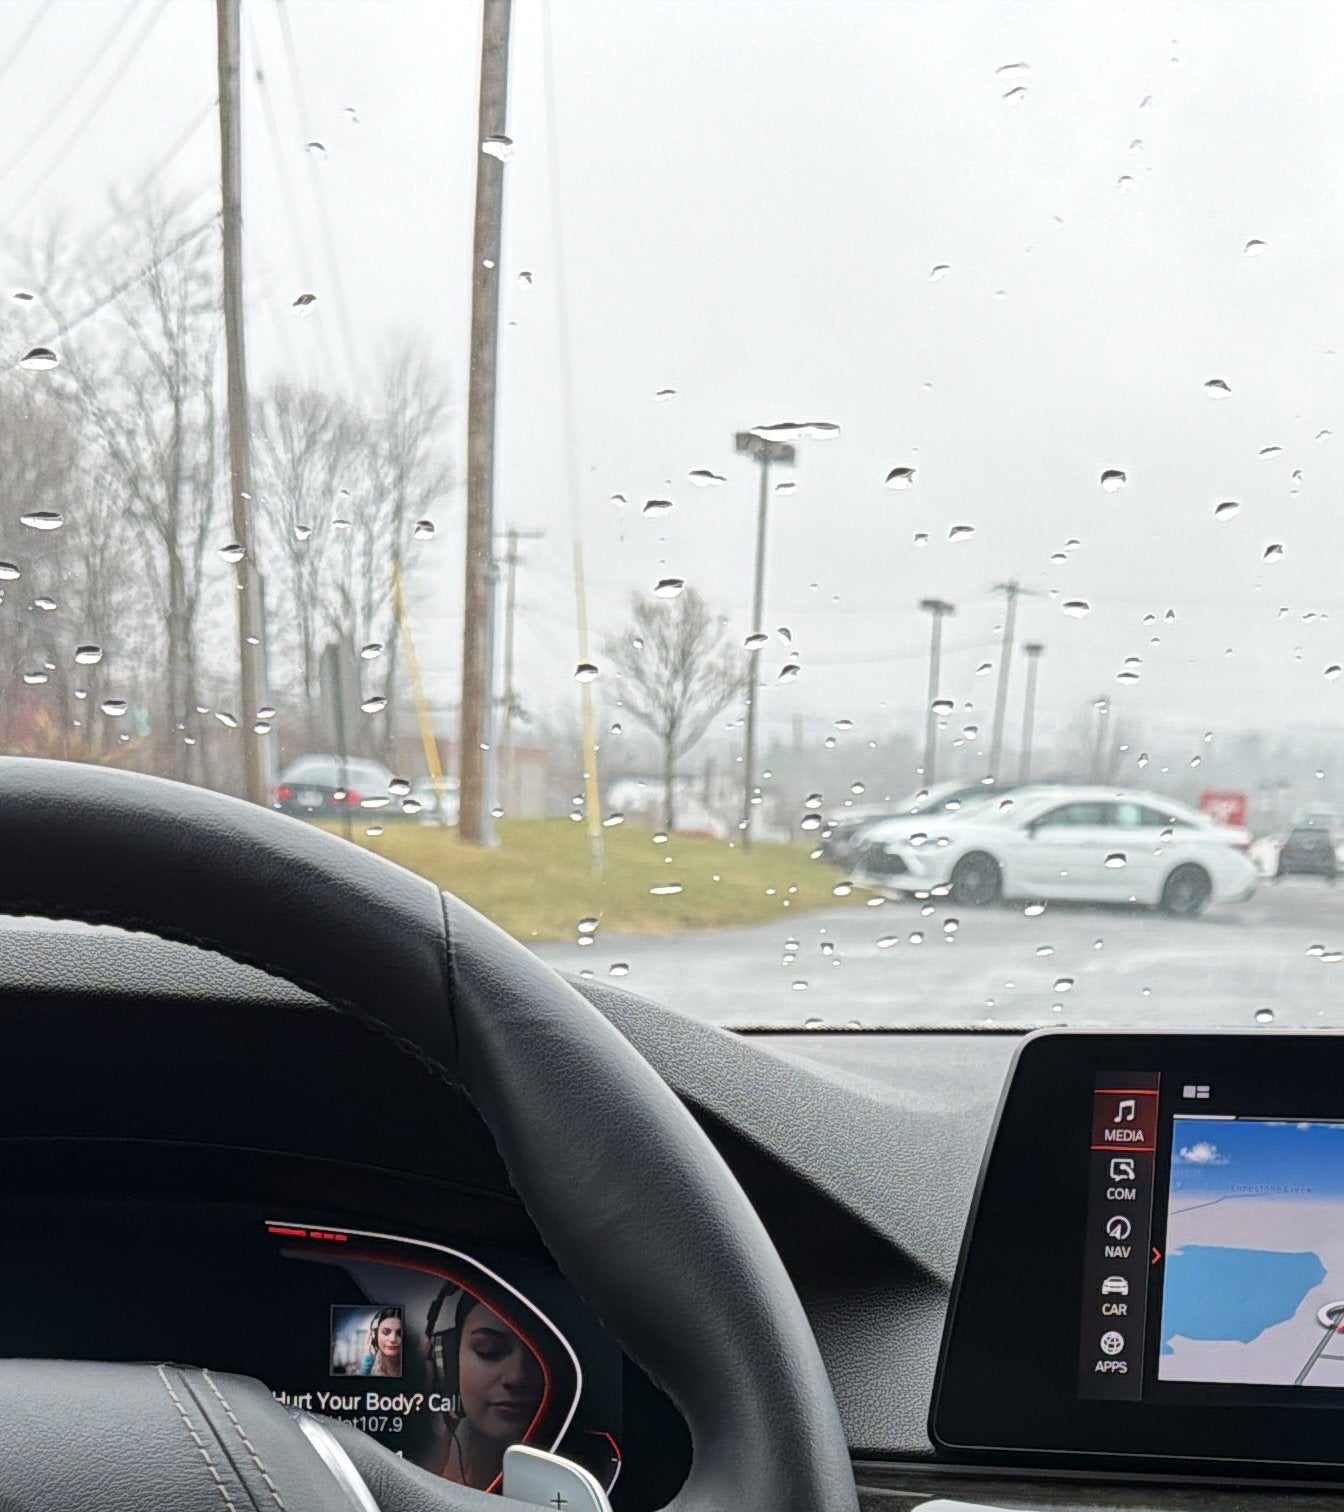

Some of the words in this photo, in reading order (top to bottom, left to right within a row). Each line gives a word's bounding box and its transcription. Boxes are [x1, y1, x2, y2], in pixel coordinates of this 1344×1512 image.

[1104, 1129, 1144, 1143] MEDIA
[1106, 1187, 1136, 1201] COM
[1104, 1245, 1131, 1259] NAV
[1102, 1303, 1127, 1317] CAR
[1094, 1360, 1129, 1375] APPS
[317, 1391, 361, 1411] Your
[366, 1392, 424, 1416] Body?
